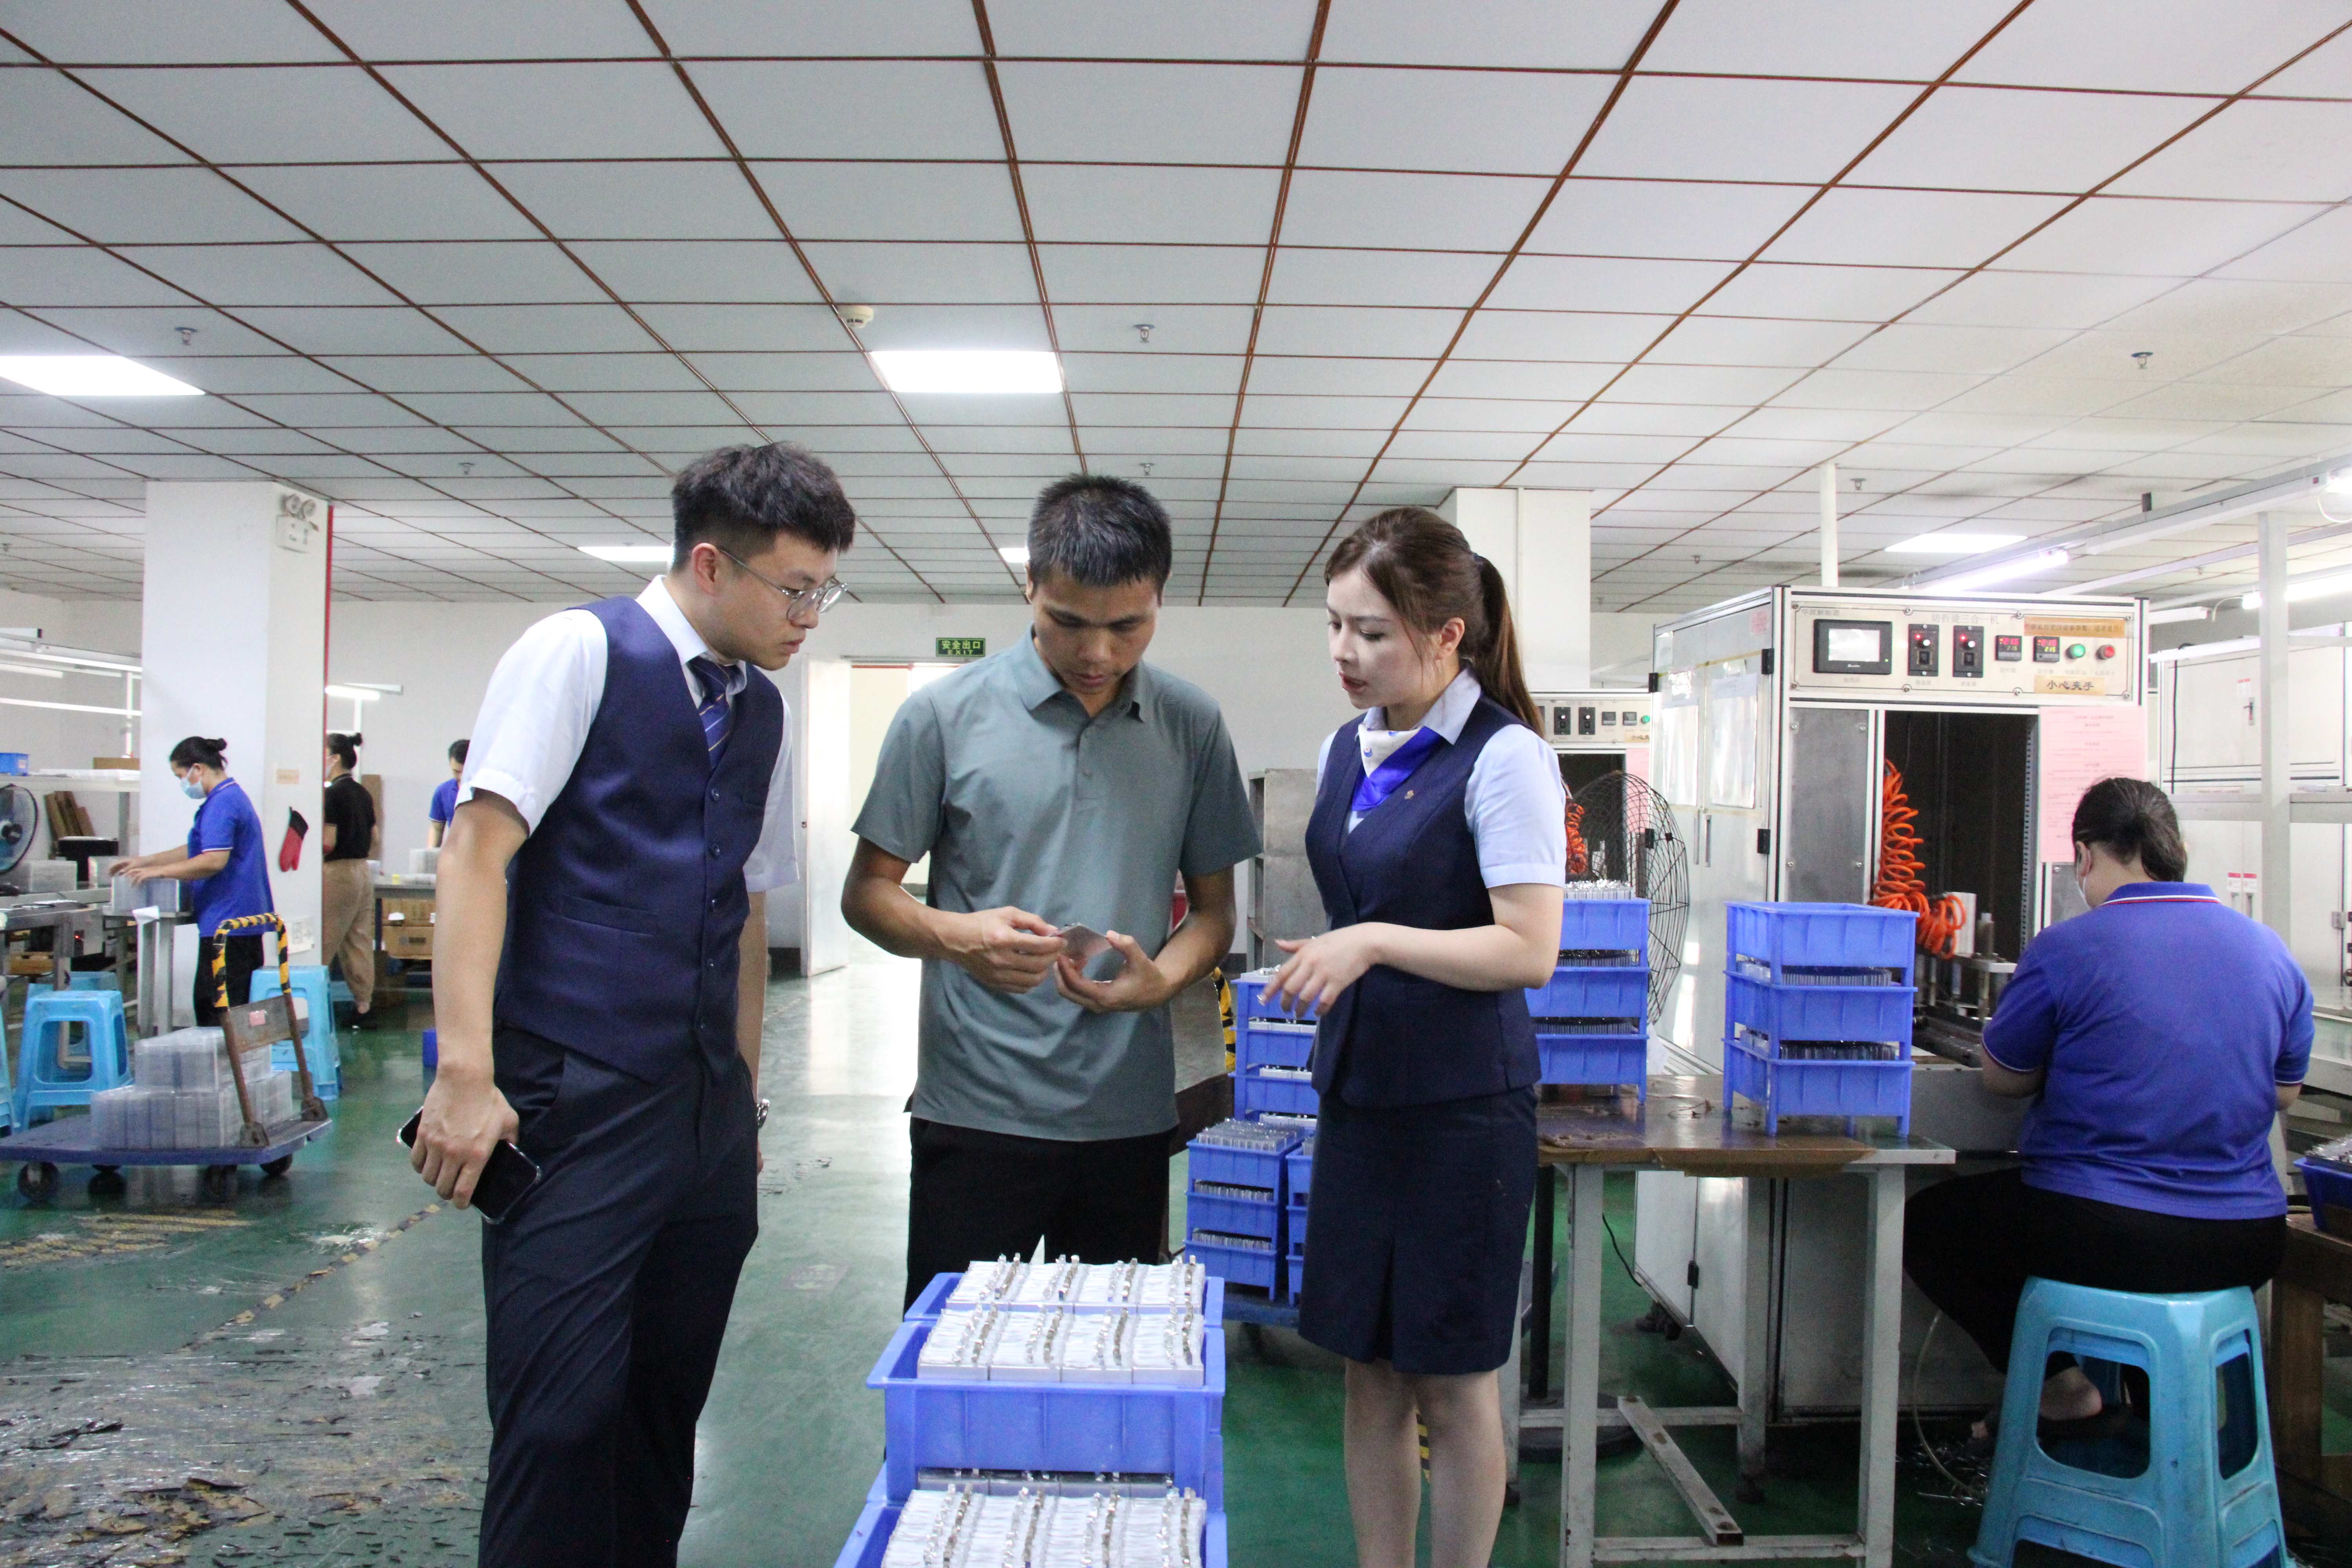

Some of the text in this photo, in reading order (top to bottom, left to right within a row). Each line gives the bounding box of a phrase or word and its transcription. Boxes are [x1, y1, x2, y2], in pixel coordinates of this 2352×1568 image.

[942, 640, 980, 649] 安全出口
[2047, 680, 2094, 691] 小心夹手
